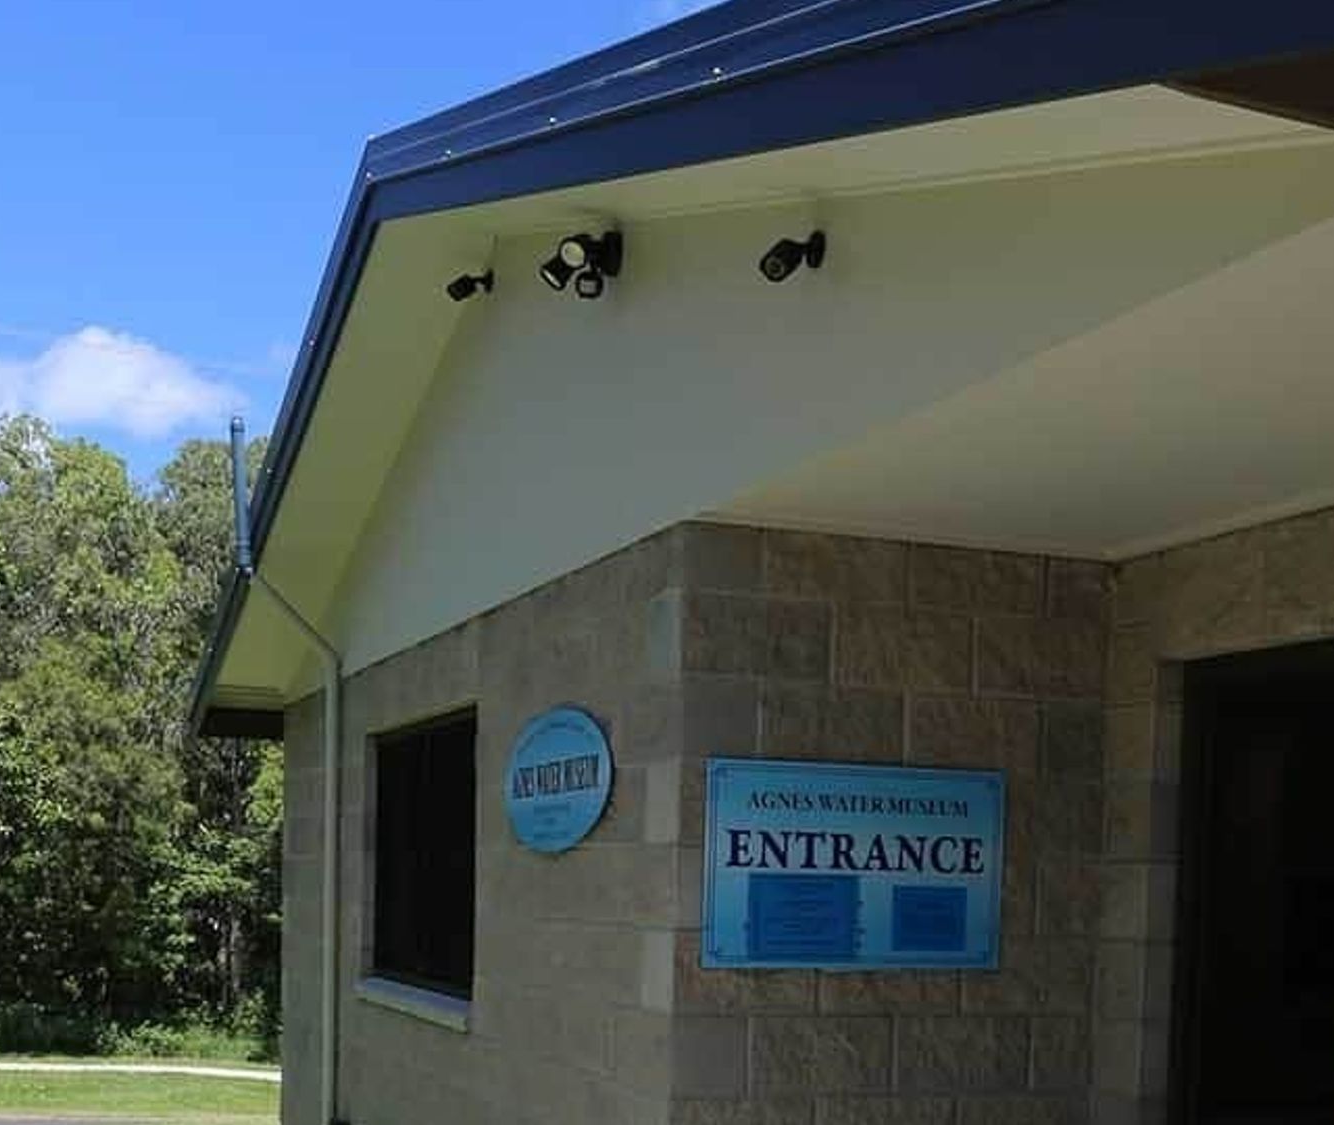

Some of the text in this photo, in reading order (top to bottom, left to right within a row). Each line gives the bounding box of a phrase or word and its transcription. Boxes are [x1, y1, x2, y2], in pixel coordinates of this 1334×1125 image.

[749, 790, 969, 818] AGNES WATER MUSEUM
[726, 829, 985, 874] ENTRANCE
